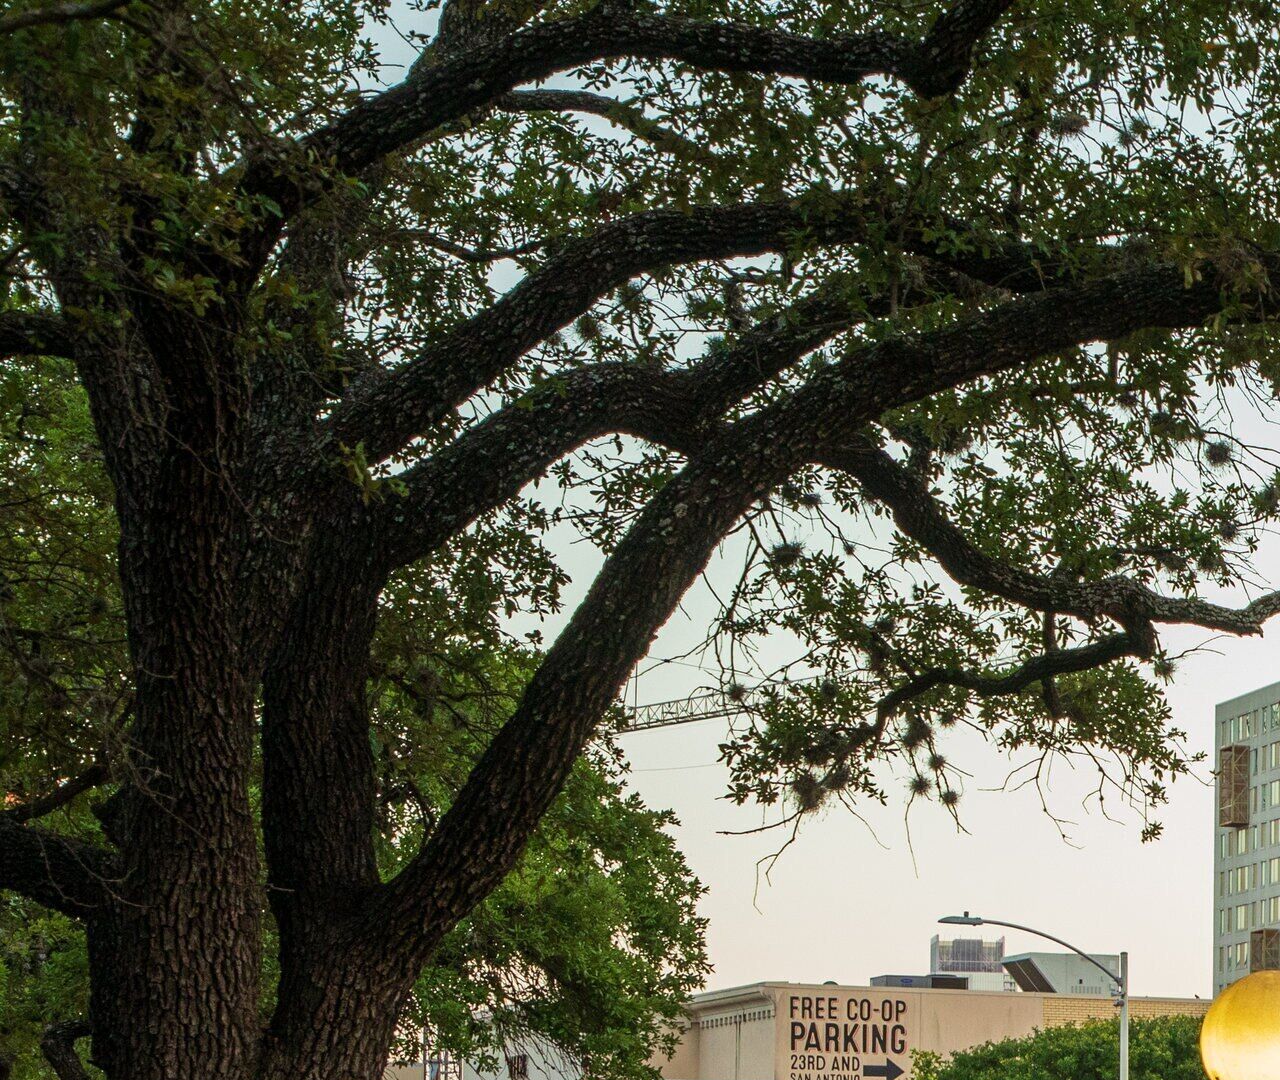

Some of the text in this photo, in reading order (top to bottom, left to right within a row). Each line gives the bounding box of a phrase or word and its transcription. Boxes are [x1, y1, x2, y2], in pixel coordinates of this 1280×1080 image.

[790, 996, 906, 1021] FREE CO-OP
[791, 1022, 906, 1054] PARKING
[791, 1055, 860, 1071] 23RD AND
